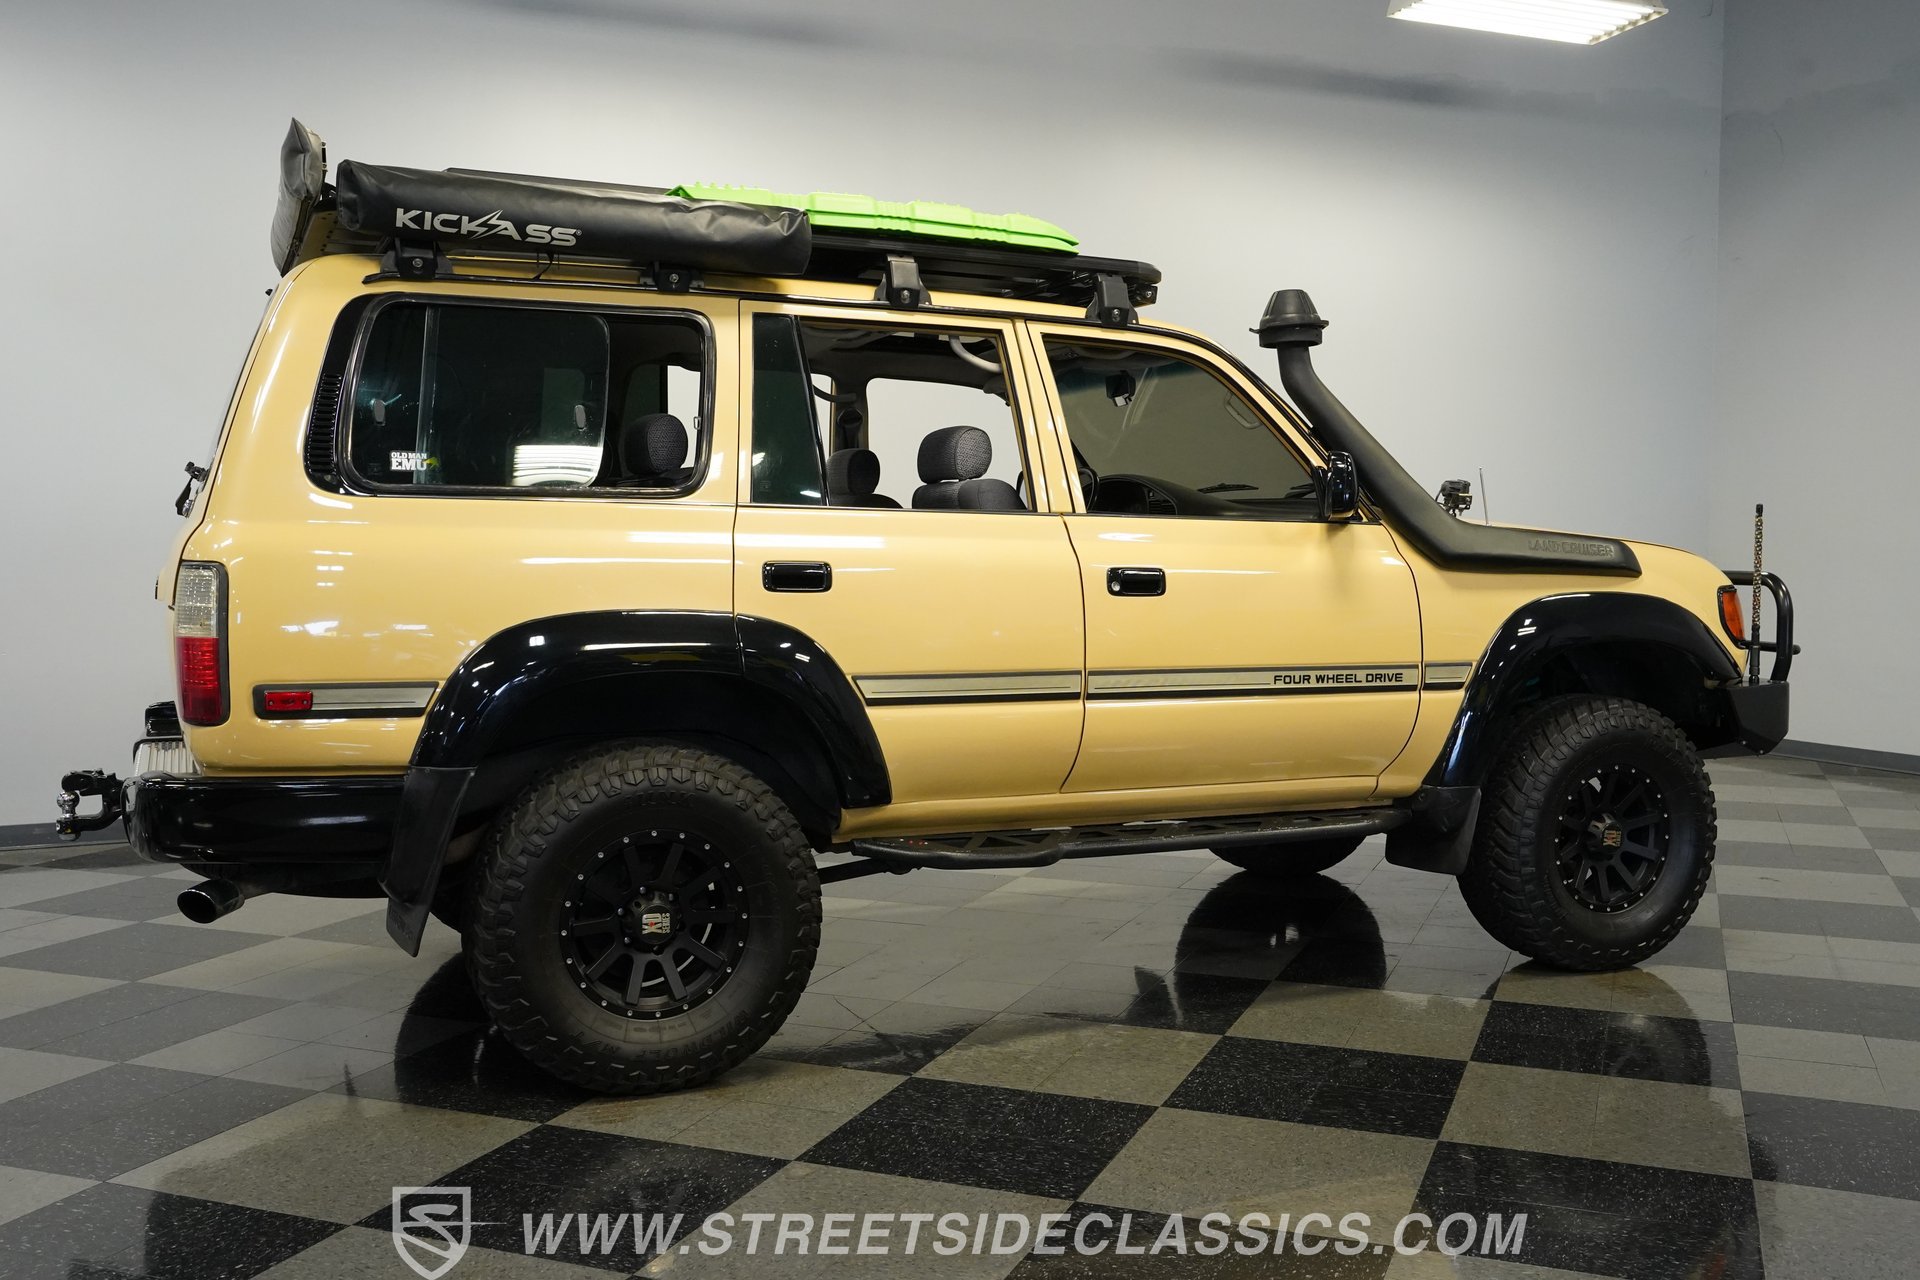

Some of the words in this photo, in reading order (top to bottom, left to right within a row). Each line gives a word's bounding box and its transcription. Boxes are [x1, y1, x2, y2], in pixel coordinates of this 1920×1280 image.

[395, 207, 578, 247] KICKASS
[391, 459, 427, 471] EMU
[1562, 541, 1615, 557] CRUISER
[1273, 674, 1311, 685] FOUR
[1315, 673, 1362, 684] WHEEL
[1365, 673, 1403, 682] DRIVE
